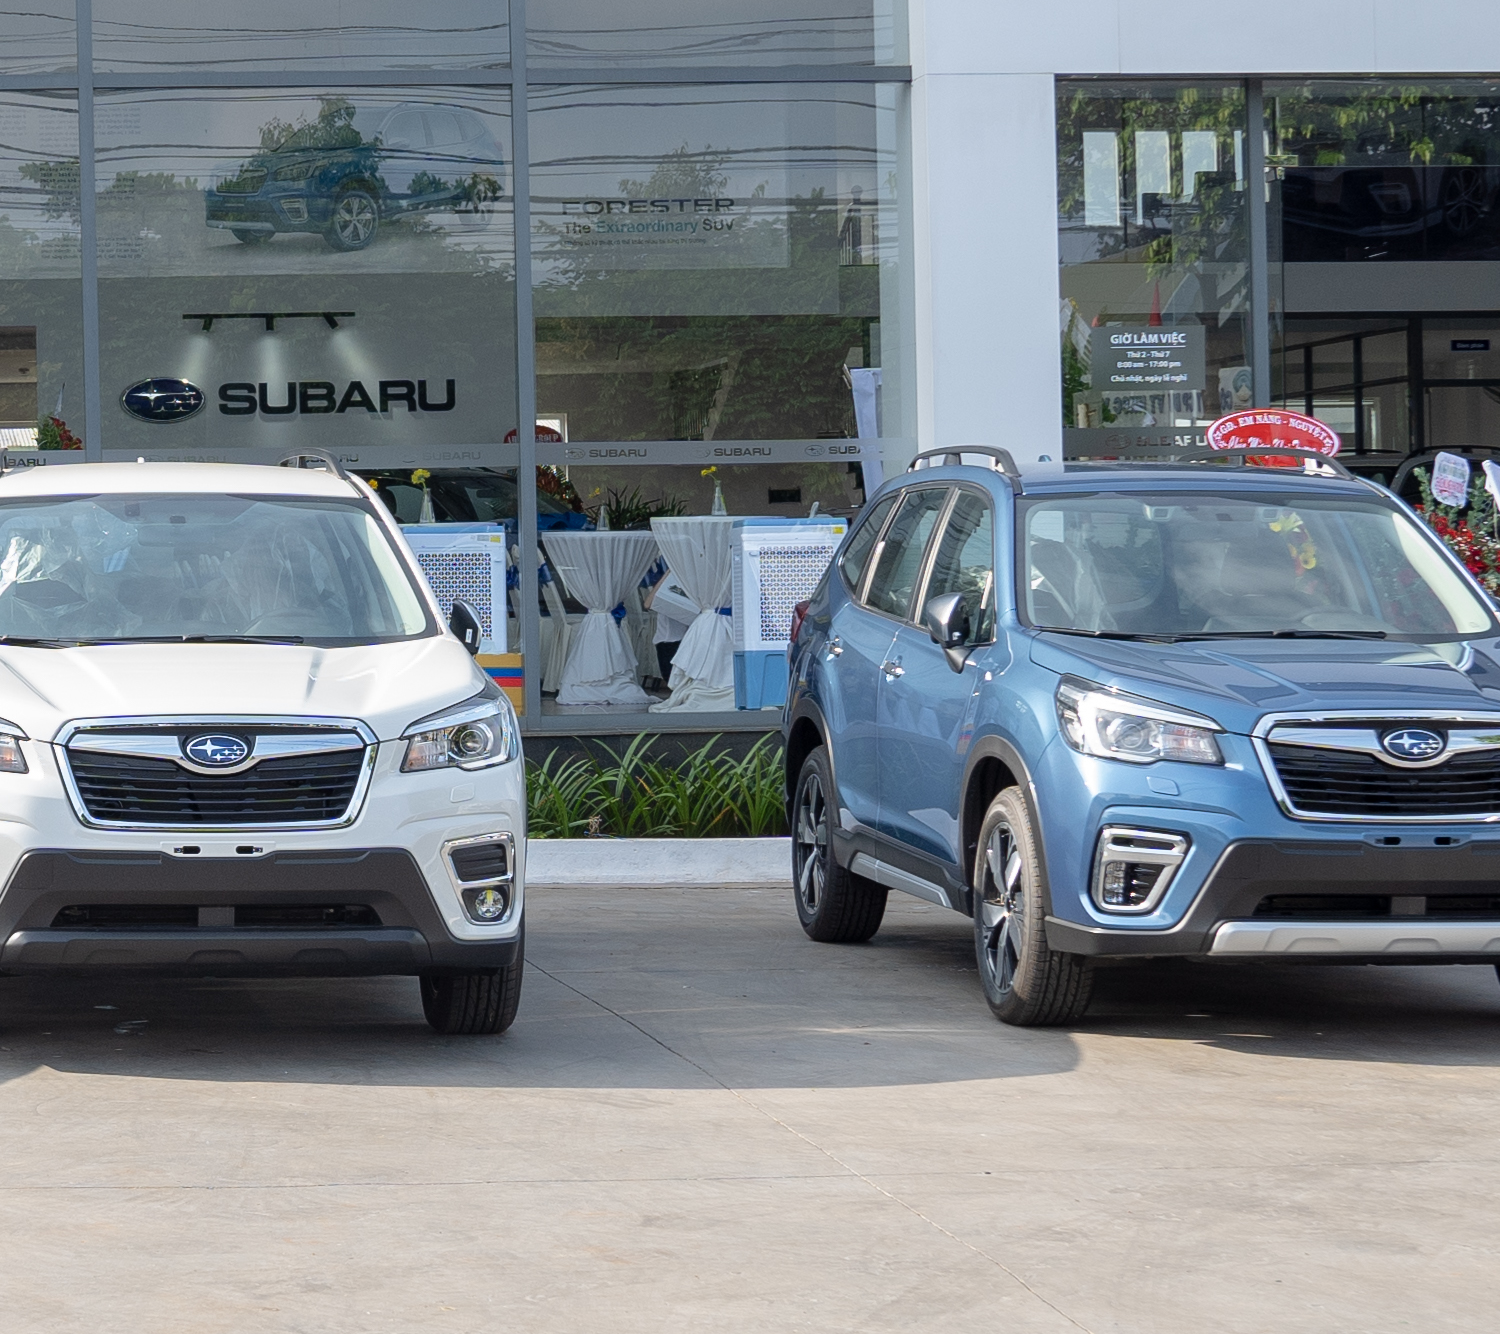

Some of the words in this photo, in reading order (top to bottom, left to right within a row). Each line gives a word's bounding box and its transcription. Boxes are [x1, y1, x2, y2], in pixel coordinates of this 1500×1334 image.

[561, 199, 735, 215] FORESTER
[564, 222, 592, 235] The
[596, 219, 699, 235] Extraordinary
[702, 218, 736, 232] SUV
[1110, 332, 1132, 345] GIỜ
[1133, 331, 1159, 344] LÀM
[1160, 331, 1187, 346] VIỆC
[218, 378, 456, 415] SUBARU
[423, 451, 482, 461] SUBARU
[588, 448, 648, 458] SUBARU
[713, 447, 772, 457] SUBARU
